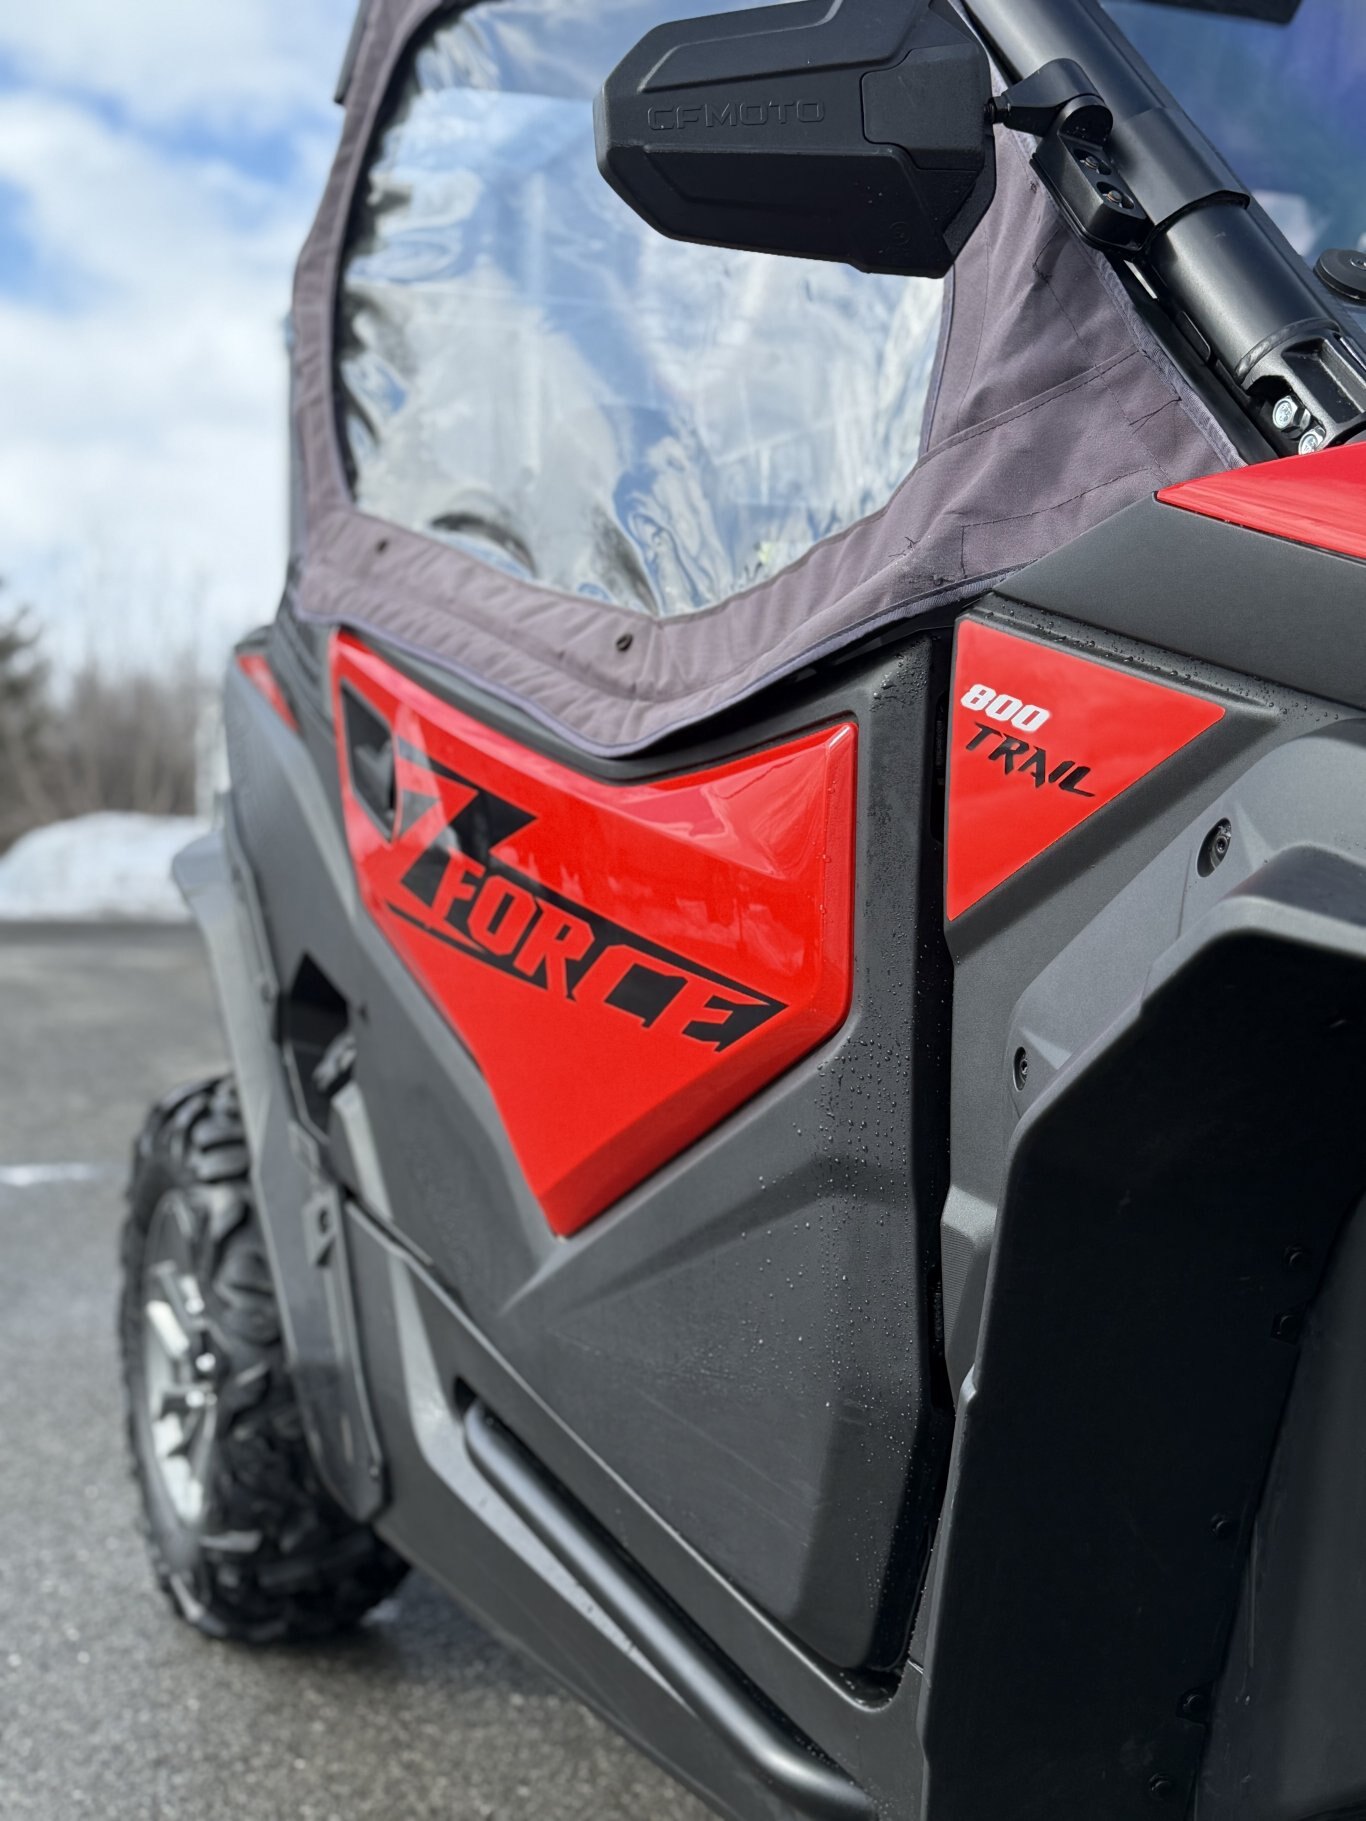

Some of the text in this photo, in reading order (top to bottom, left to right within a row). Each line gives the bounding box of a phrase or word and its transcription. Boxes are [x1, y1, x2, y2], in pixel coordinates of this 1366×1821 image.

[647, 100, 826, 131] CFMOTO
[960, 683, 1053, 733] 800
[965, 721, 1096, 798] TRAIL
